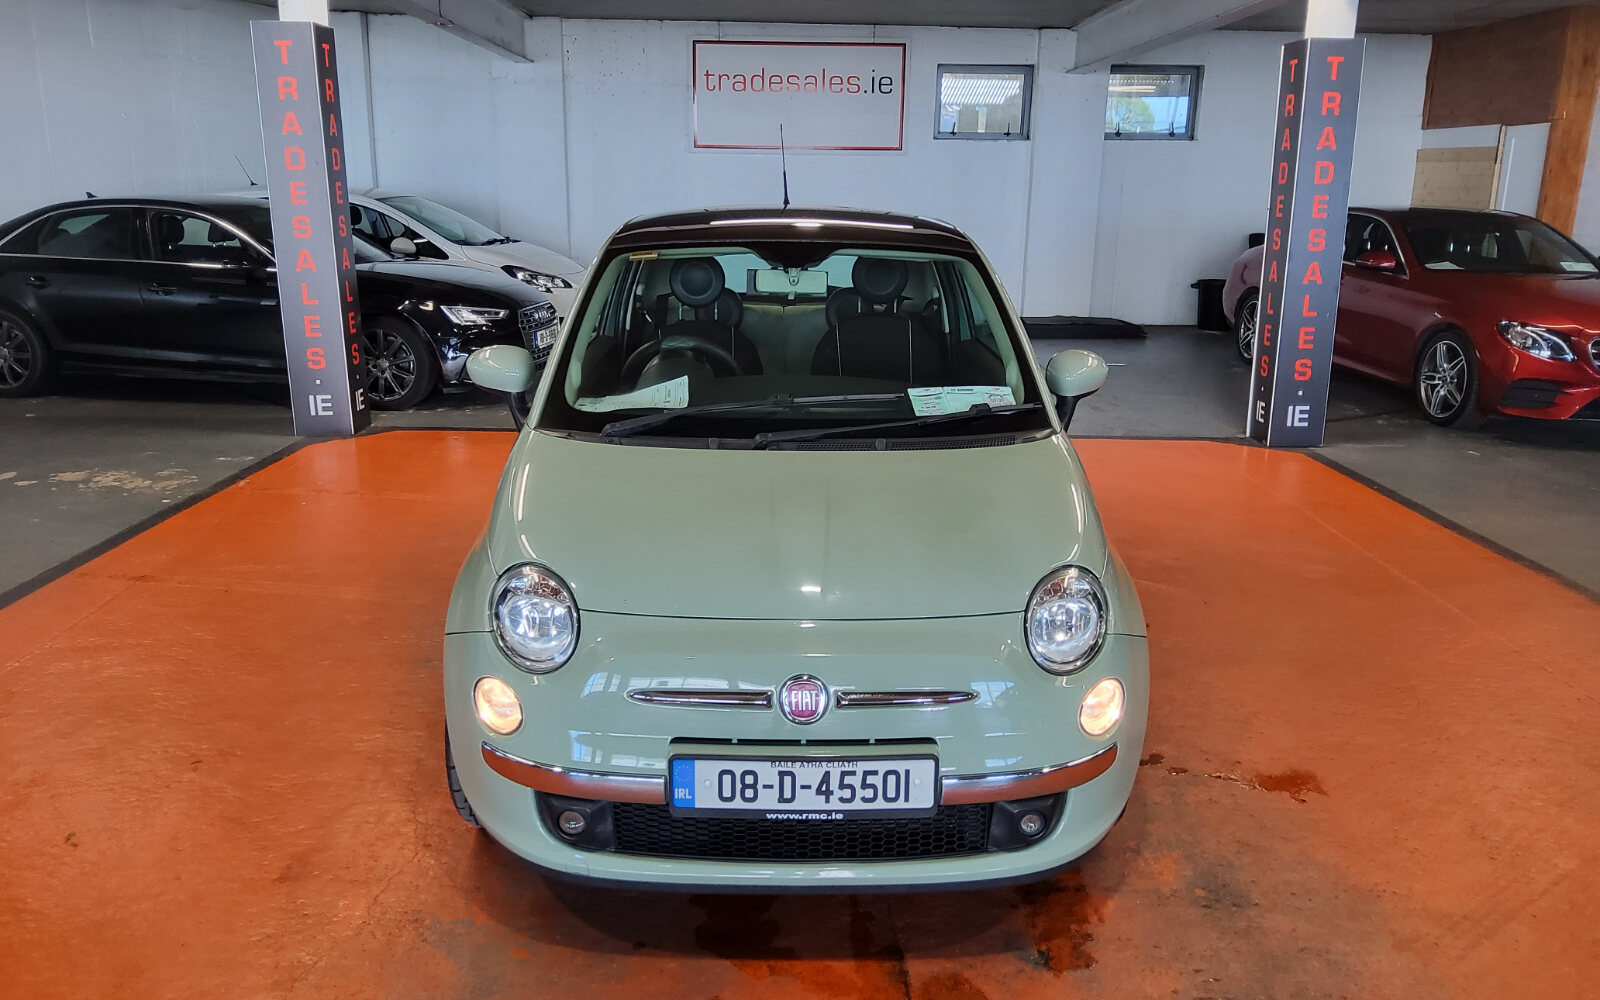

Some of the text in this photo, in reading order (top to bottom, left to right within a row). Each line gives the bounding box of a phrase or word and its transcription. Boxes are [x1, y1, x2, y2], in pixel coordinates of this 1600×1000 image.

[704, 67, 893, 94] tradesales.ie
[791, 690, 818, 711] FIAT
[770, 760, 796, 768] BAILE
[826, 760, 858, 768] CLIATH
[674, 788, 692, 799] IRL
[717, 769, 910, 804] 08-D-45501
